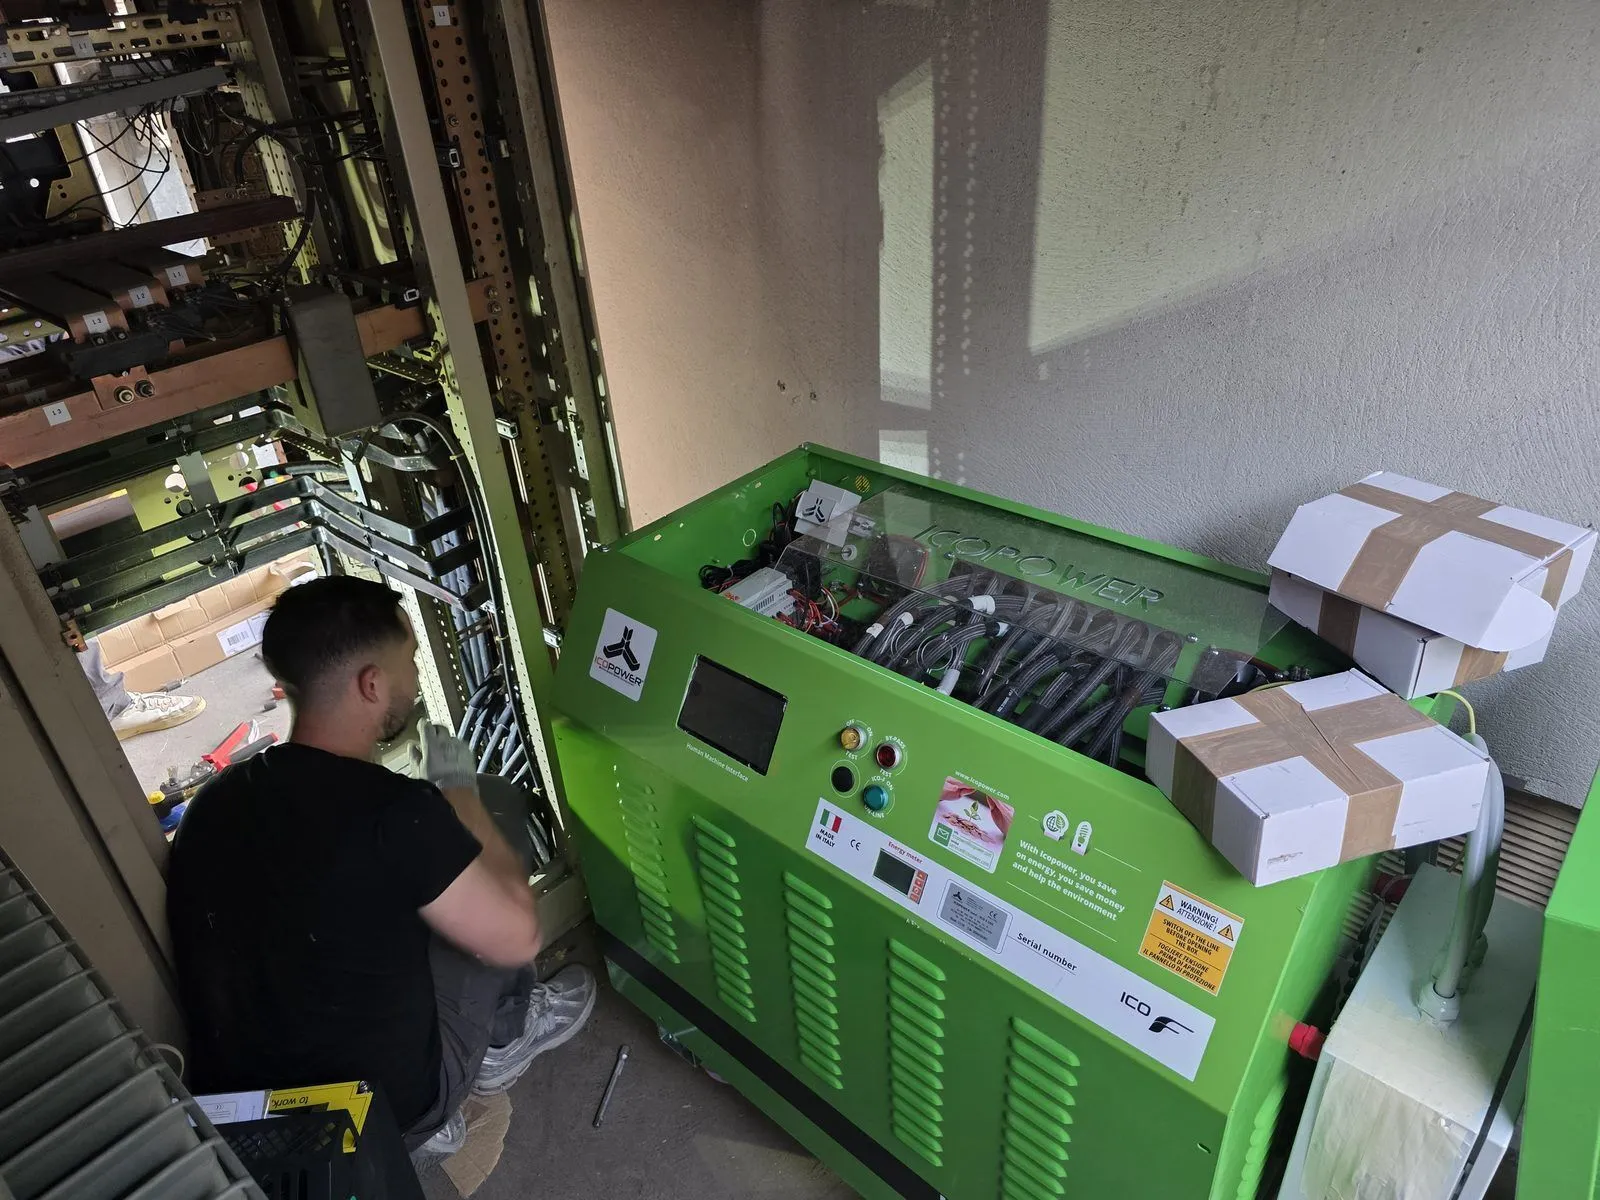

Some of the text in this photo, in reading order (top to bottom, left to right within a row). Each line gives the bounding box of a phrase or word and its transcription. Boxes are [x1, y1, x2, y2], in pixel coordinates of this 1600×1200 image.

[913, 525, 1164, 612] ICOPOWER
[595, 656, 642, 686] ICOPOWER
[686, 742, 749, 782] Human Machine Interface
[845, 750, 858, 760] TEST
[880, 768, 892, 778] TEST
[820, 828, 834, 840] MADE
[822, 836, 835, 848] ITALY
[888, 841, 922, 864] Energy meter
[1016, 852, 1126, 912] on energy, you save money
[1020, 840, 1118, 896] With Icopower, you save
[1012, 862, 1118, 920] and help the environment
[1180, 900, 1219, 924] WARNING!
[1163, 919, 1220, 952] SWITCH OFF THE LINE
[1166, 927, 1212, 956] BEFORE OPENING
[1176, 940, 1198, 956] THE BOX
[1017, 932, 1078, 972] Serial number
[1158, 942, 1209, 973] TOGLIERE TENSIONE
[1159, 951, 1177, 963] PRIMA
[1184, 963, 1204, 978] APRIRE
[1148, 952, 1176, 970] PANNELLO
[1182, 969, 1216, 992] PROTEZIONE
[1120, 991, 1151, 1017] ICO
[300, 1096, 308, 1104] to
